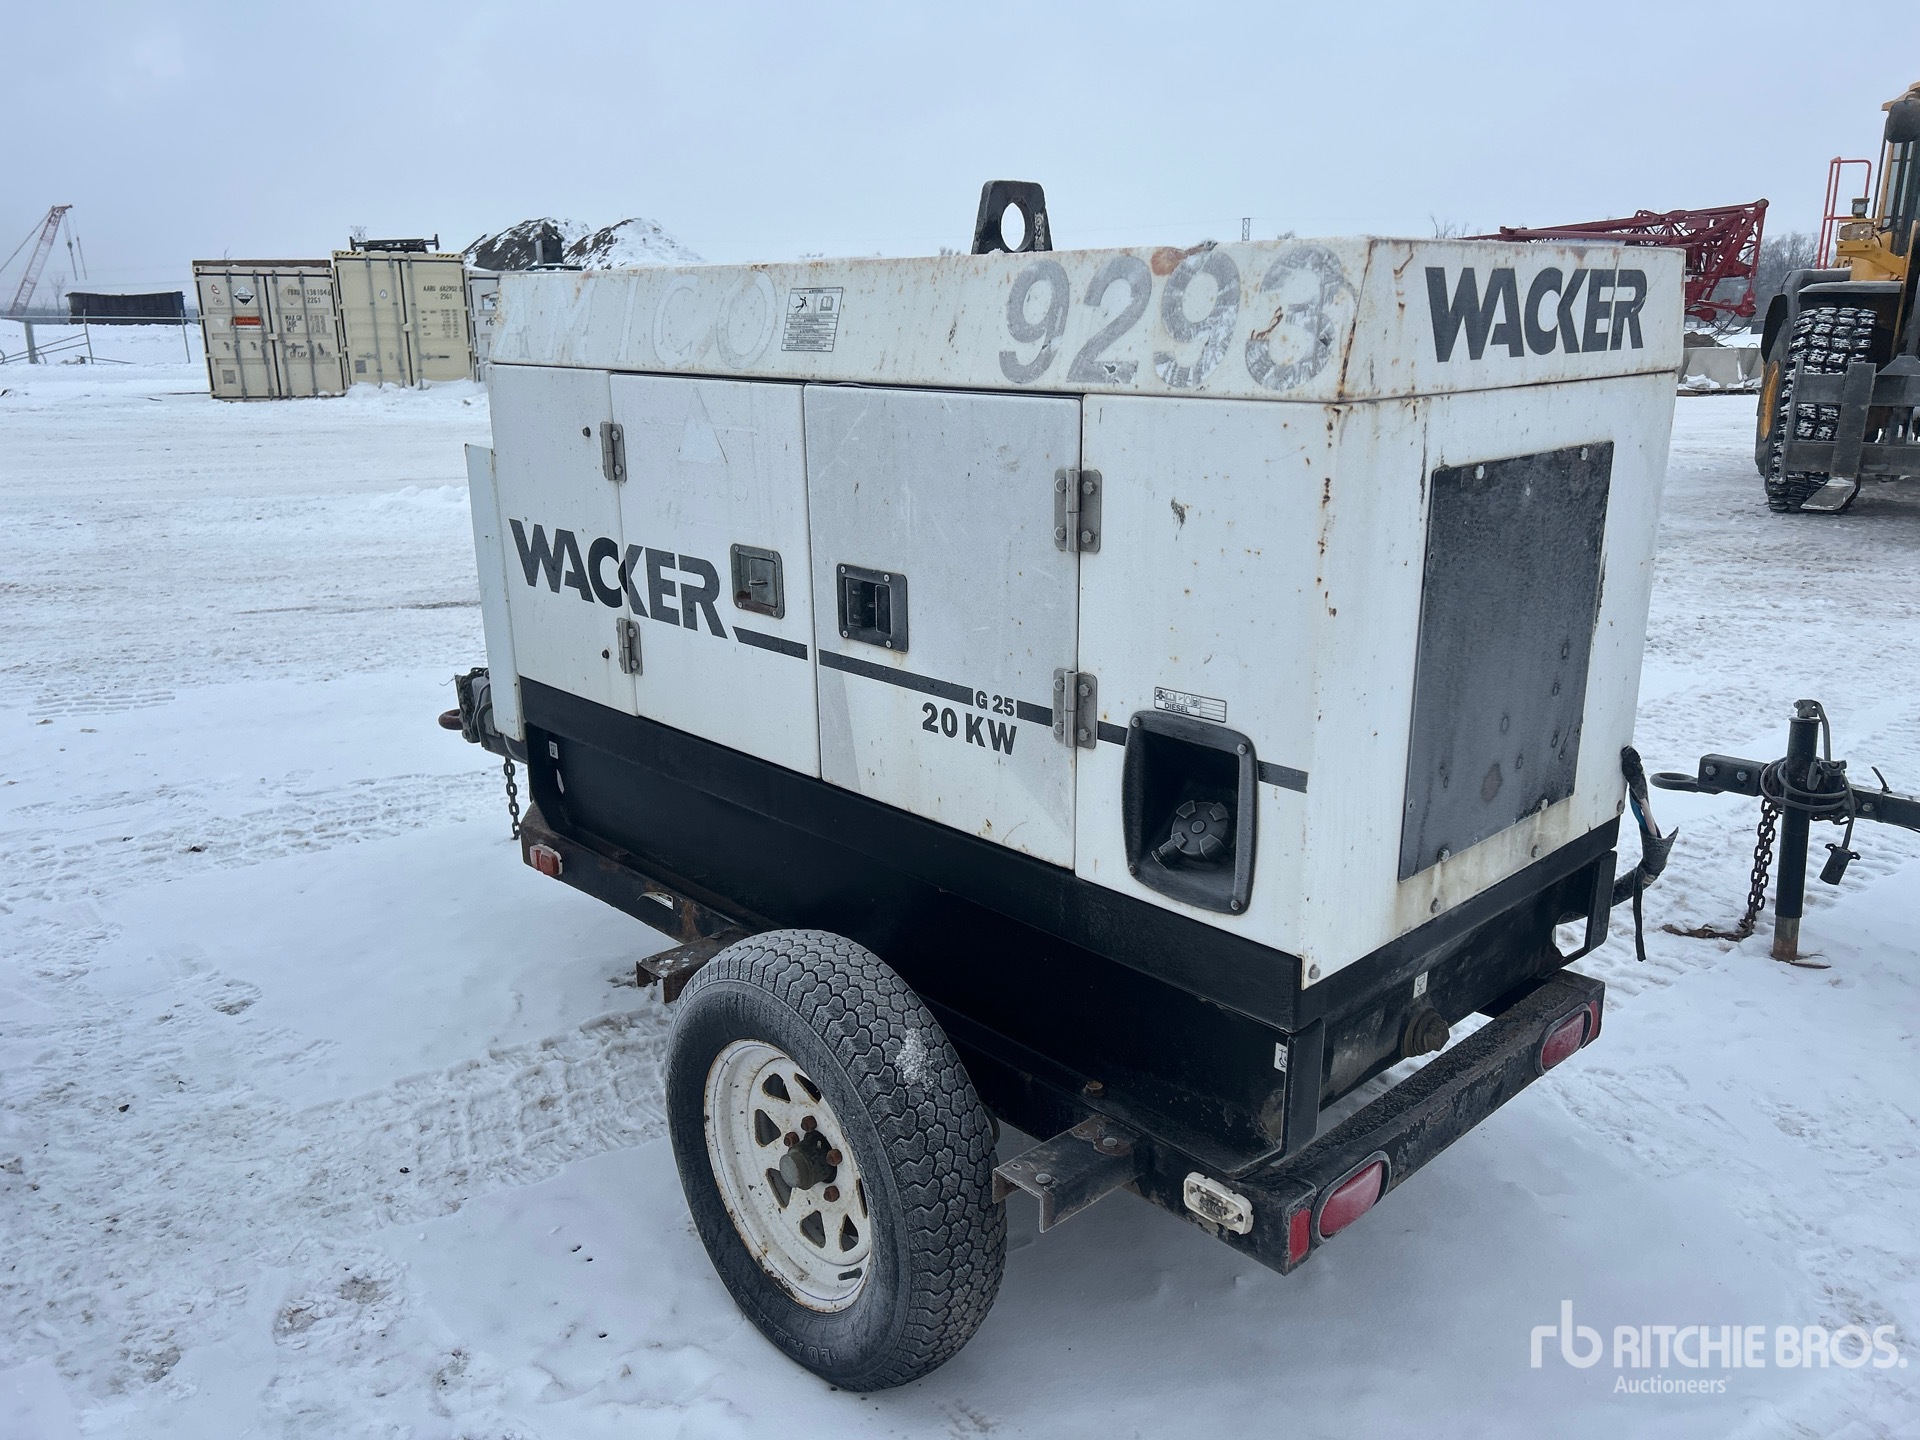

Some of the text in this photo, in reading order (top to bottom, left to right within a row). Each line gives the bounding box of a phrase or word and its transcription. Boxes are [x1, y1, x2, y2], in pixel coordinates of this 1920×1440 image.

[999, 249, 1343, 391] 9293
[1425, 267, 1647, 363] WACKER
[508, 518, 728, 639] WACKER
[922, 702, 1017, 756] 20 KW
[975, 690, 1015, 717] G 25
[1164, 702, 1190, 713] DIESEL
